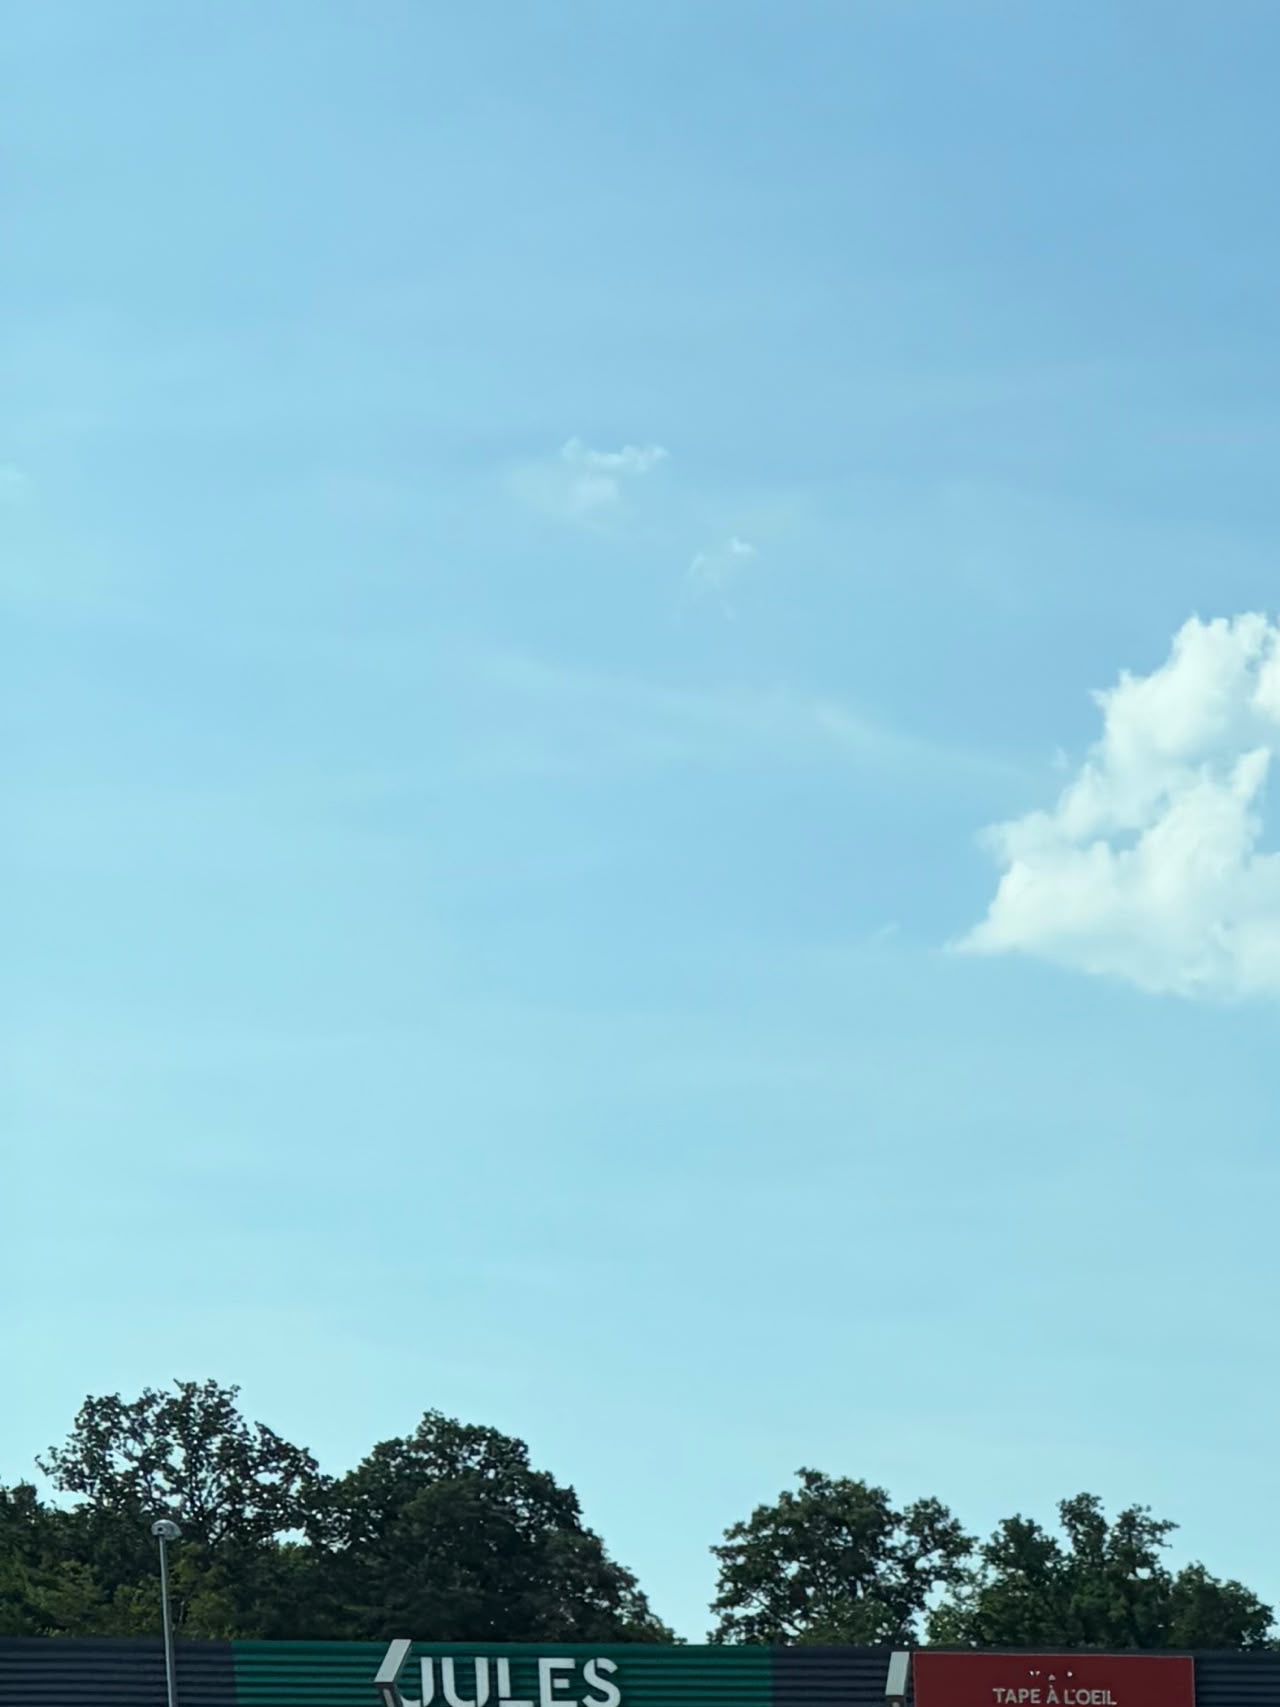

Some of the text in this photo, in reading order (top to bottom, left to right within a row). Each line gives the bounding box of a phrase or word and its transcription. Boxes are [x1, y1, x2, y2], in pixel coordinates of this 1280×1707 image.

[992, 1684, 1118, 1705] TAPE À L'OEIL
